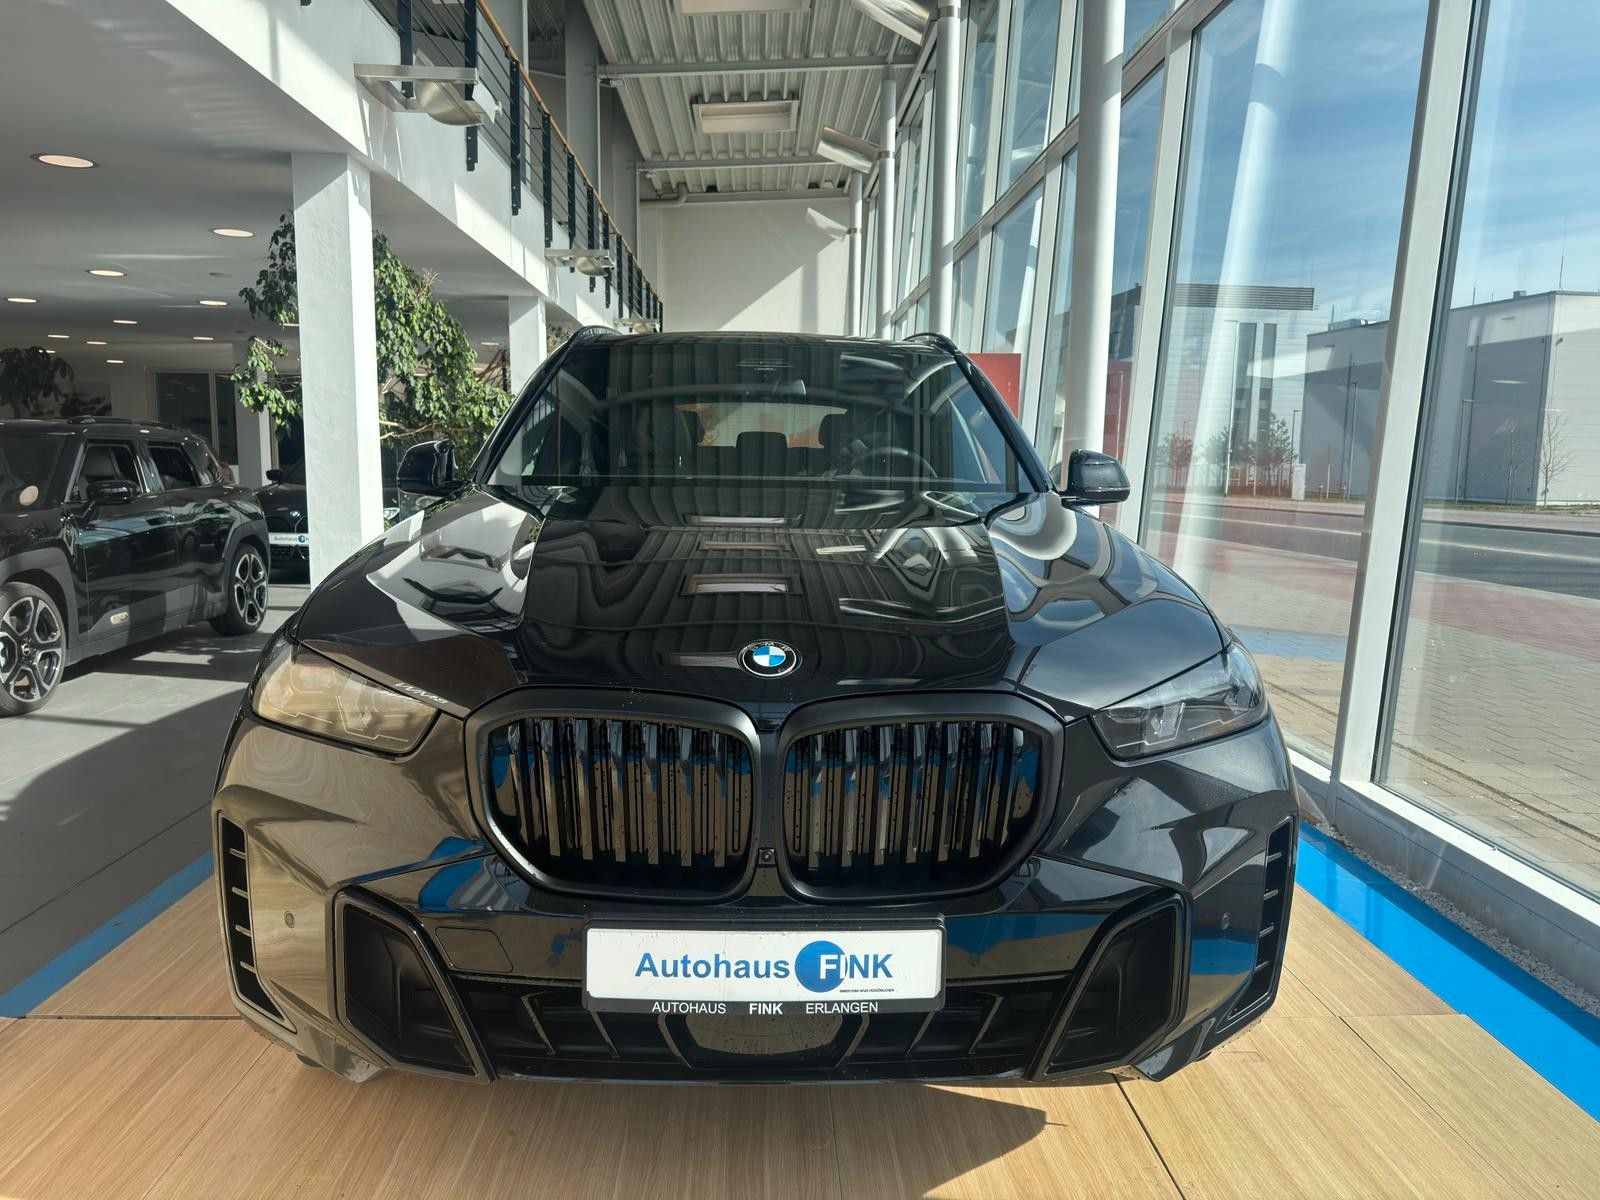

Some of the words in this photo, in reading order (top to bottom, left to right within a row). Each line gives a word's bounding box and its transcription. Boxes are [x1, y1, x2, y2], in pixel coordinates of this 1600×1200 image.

[634, 952, 790, 979] Autohaus
[818, 953, 893, 980] FINK
[652, 1001, 726, 1014] AUTOHAUS
[749, 1002, 783, 1015] FINK
[806, 1001, 879, 1014] ERLANGEN
